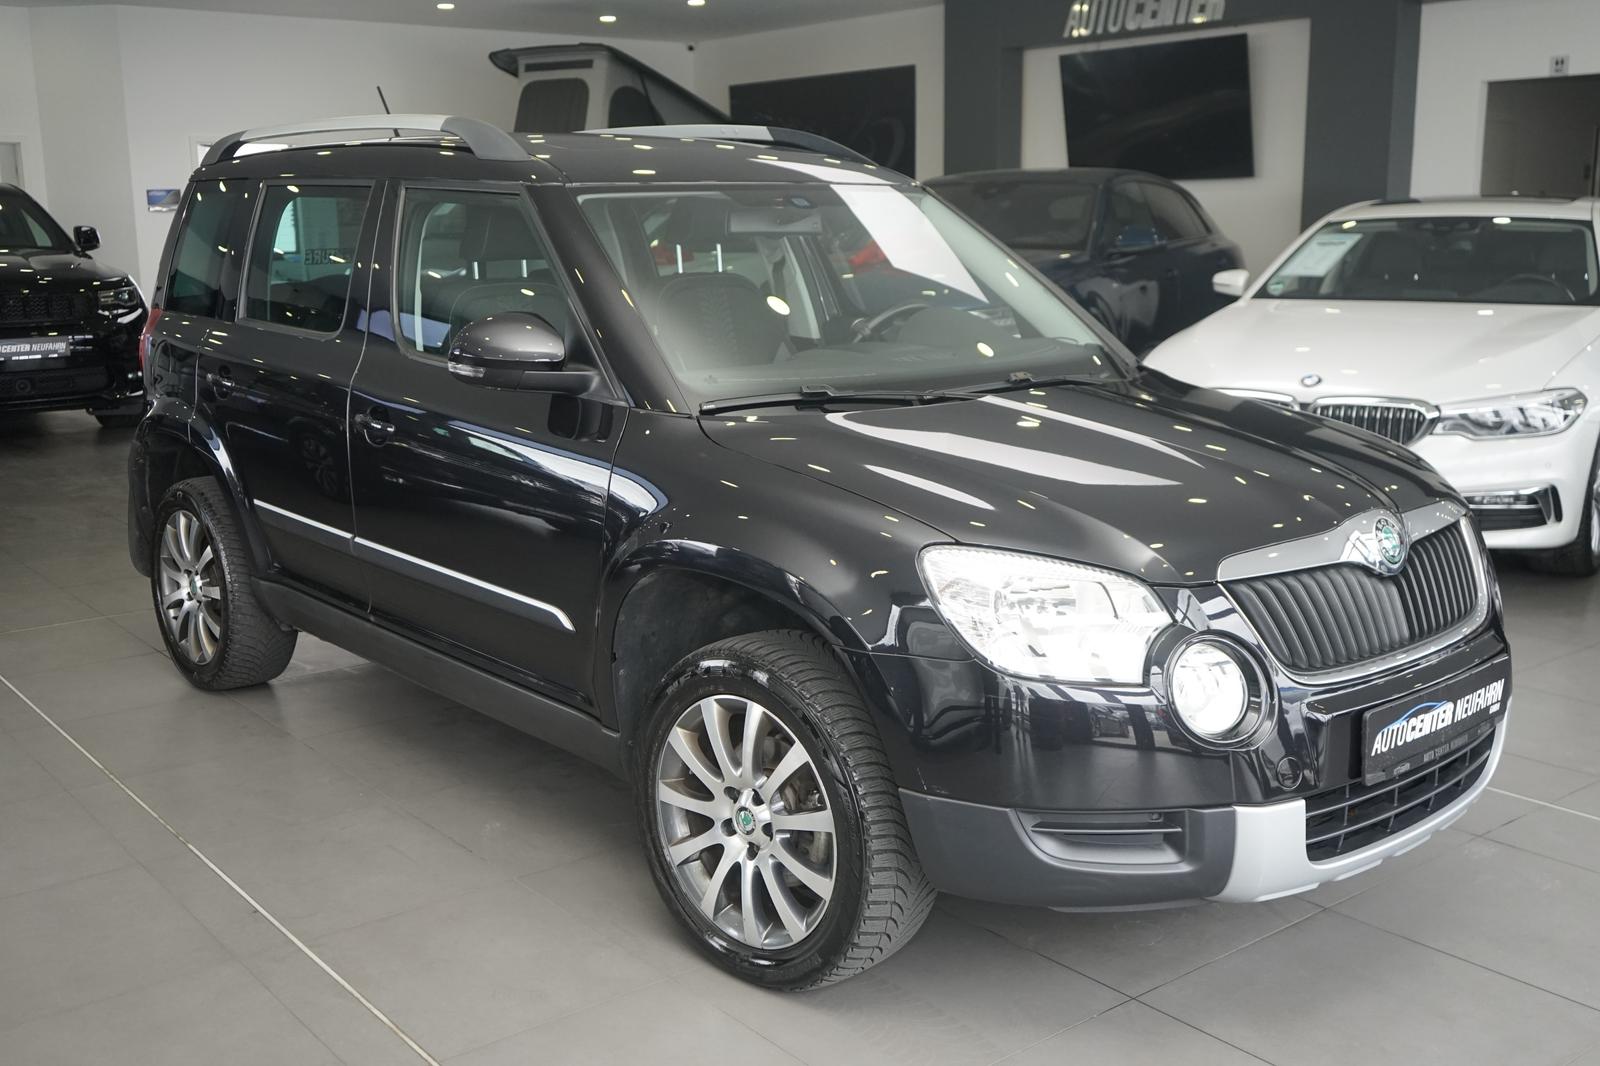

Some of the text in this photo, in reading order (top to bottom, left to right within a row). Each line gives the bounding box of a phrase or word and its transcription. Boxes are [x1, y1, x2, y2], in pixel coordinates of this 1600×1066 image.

[0, 341, 67, 354] CENTER NEUFAHRN
[1371, 678, 1505, 757] AUTOCENTER NEUFAHRN
